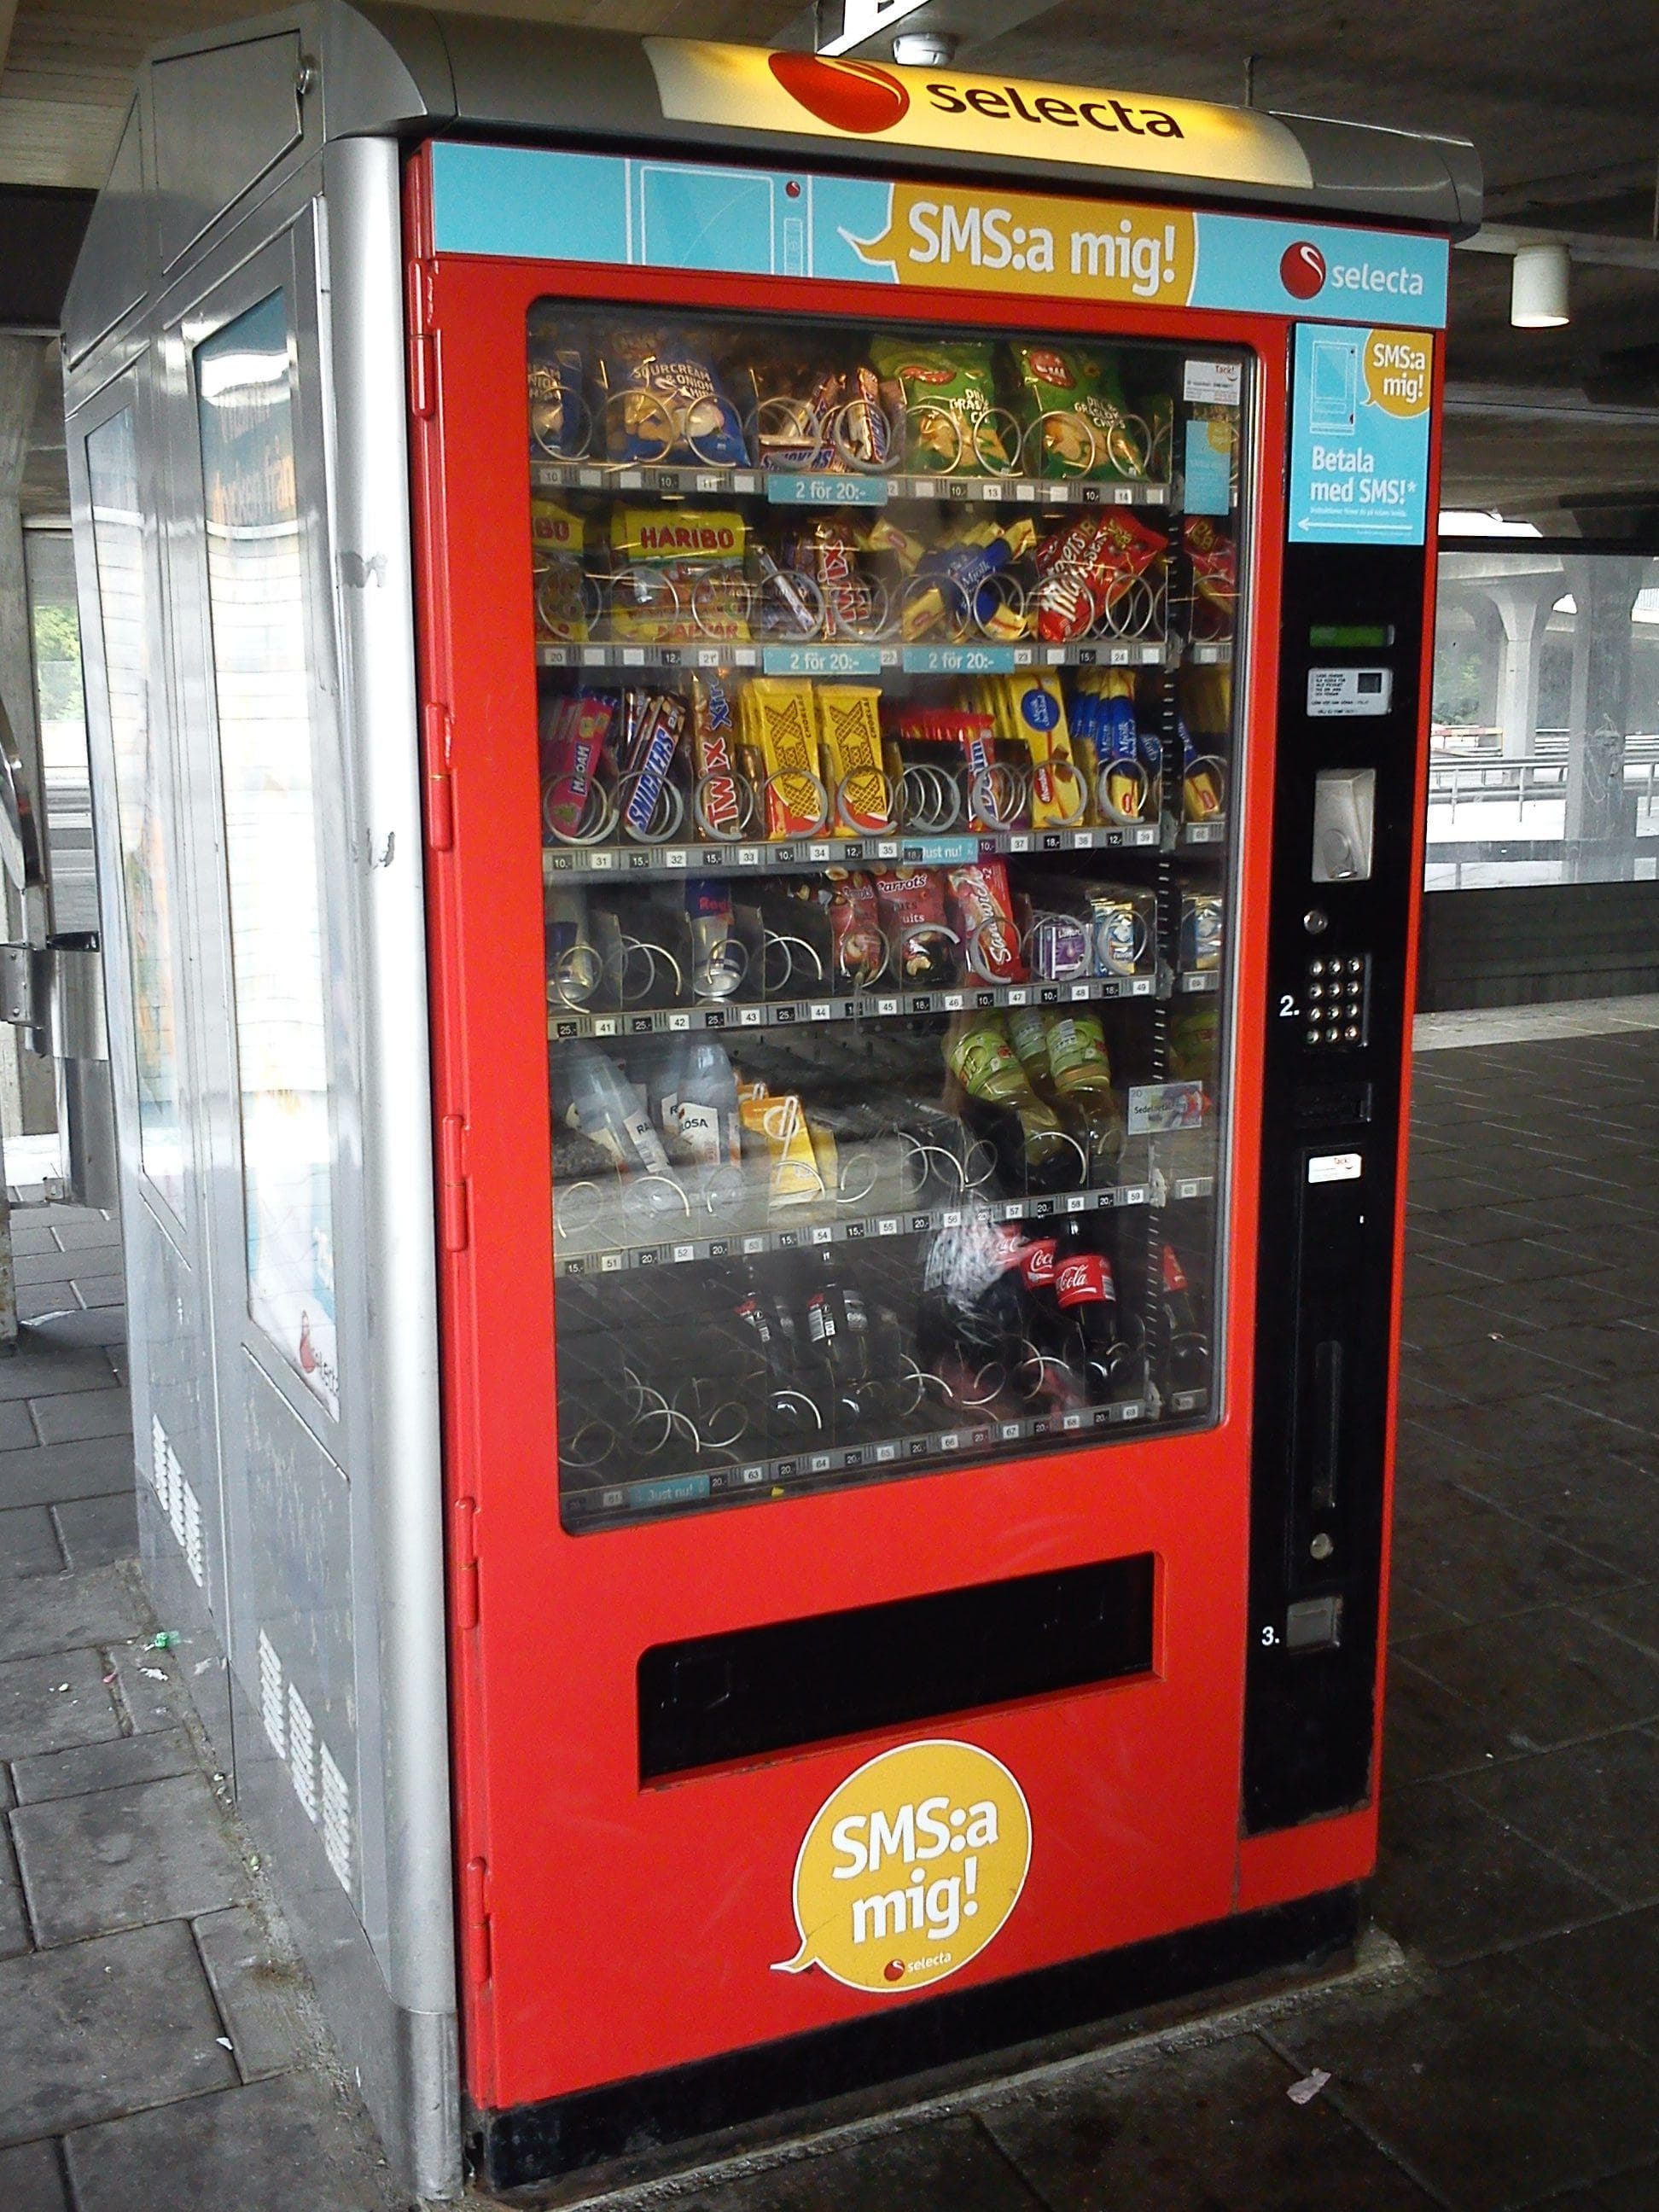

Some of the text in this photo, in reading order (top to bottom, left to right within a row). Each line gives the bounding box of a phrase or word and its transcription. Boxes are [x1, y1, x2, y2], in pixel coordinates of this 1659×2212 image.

[926, 83, 1185, 138] selecta
[908, 201, 1175, 297] SMS:a mig!
[1331, 264, 1423, 295] selecta
[1373, 343, 1425, 370] SMS:a
[1383, 374, 1423, 404] mig!
[1312, 445, 1374, 472] Betala
[796, 480, 865, 500] 2 för 20:-
[1120, 492, 1128, 501] 14
[1311, 477, 1353, 502] med
[641, 527, 734, 550] HARIBO
[790, 651, 859, 670] 2 för 20:-
[928, 651, 994, 670] 2 för 20:-
[627, 725, 676, 835] SNICKERS
[703, 737, 739, 830] TWIX
[671, 855, 682, 864] 32
[744, 853, 754, 862] 33
[815, 849, 824, 858] 34
[883, 846, 894, 854] 35
[596, 857, 607, 865] 31
[877, 874, 928, 894] Parrots
[883, 1003, 893, 1011] 45
[949, 998, 959, 1007] 46
[1280, 995, 1300, 1016] 2.
[675, 1017, 685, 1026] 42
[815, 1009, 826, 1017] 44
[601, 1023, 611, 1032] 41
[818, 1231, 828, 1240] 54
[883, 1223, 894, 1231] 55
[678, 1249, 688, 1257] 52
[607, 1259, 617, 1267] 51
[1059, 1265, 1088, 1292] Cola
[815, 1459, 826, 1468] 64
[748, 1470, 759, 1479] 63
[1261, 1627, 1280, 1645] 3.
[831, 1796, 999, 1879] SMS:a
[853, 1855, 978, 1944] mig!
[907, 1952, 952, 1973] selecta
